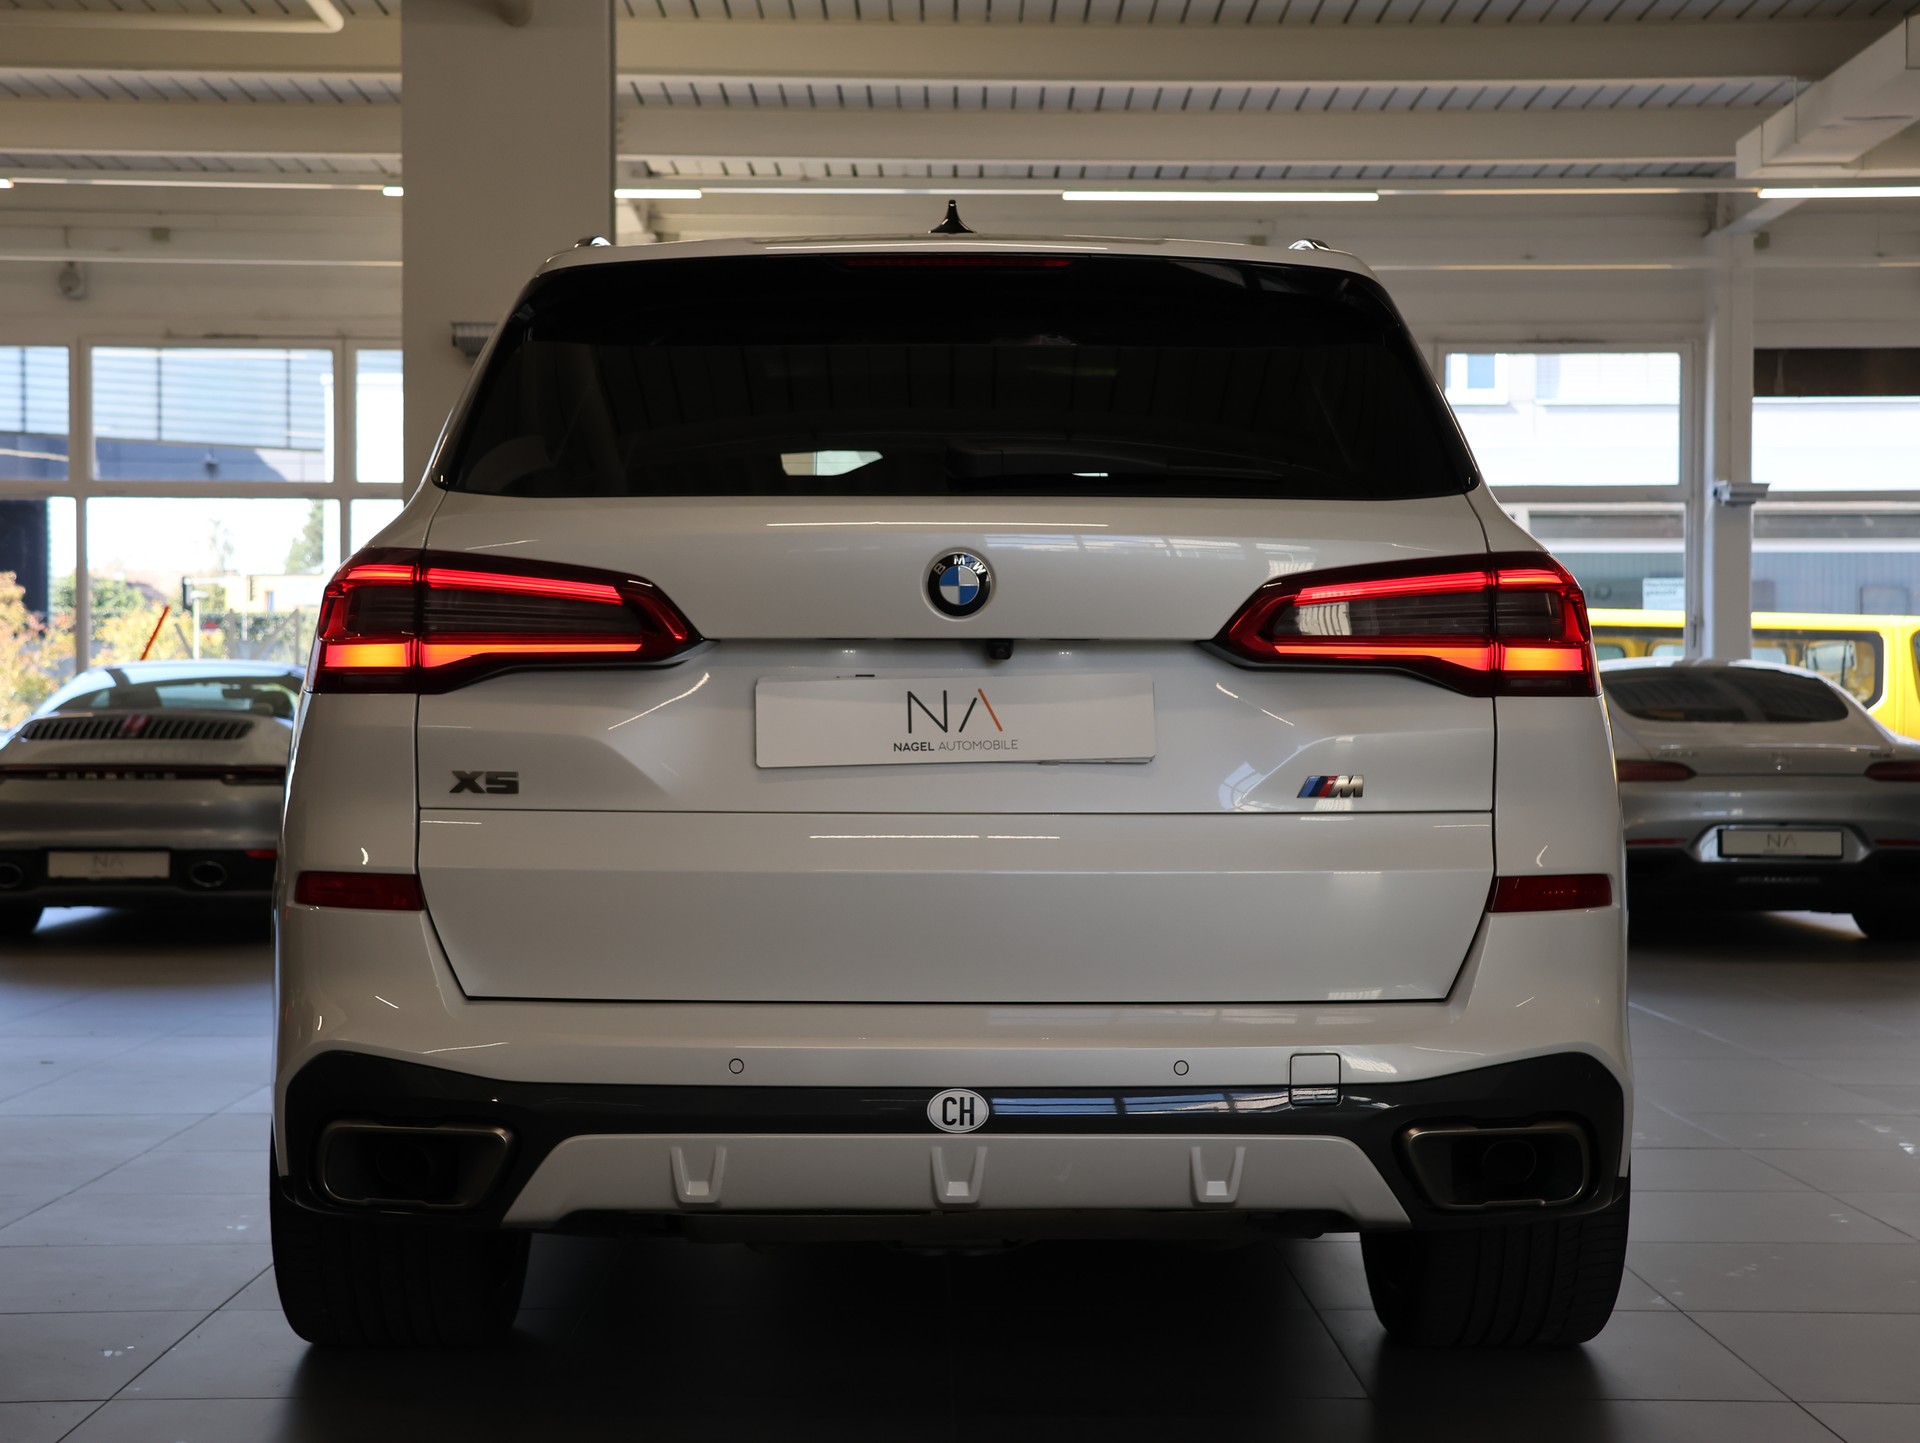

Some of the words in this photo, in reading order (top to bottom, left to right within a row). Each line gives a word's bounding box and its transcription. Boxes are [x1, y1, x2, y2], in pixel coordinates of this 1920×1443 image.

[933, 554, 987, 575] BMW
[893, 742, 935, 752] NAGEL
[938, 739, 1019, 752] AUTOMOBILE
[449, 770, 519, 795] X5
[942, 1096, 975, 1126] CH
